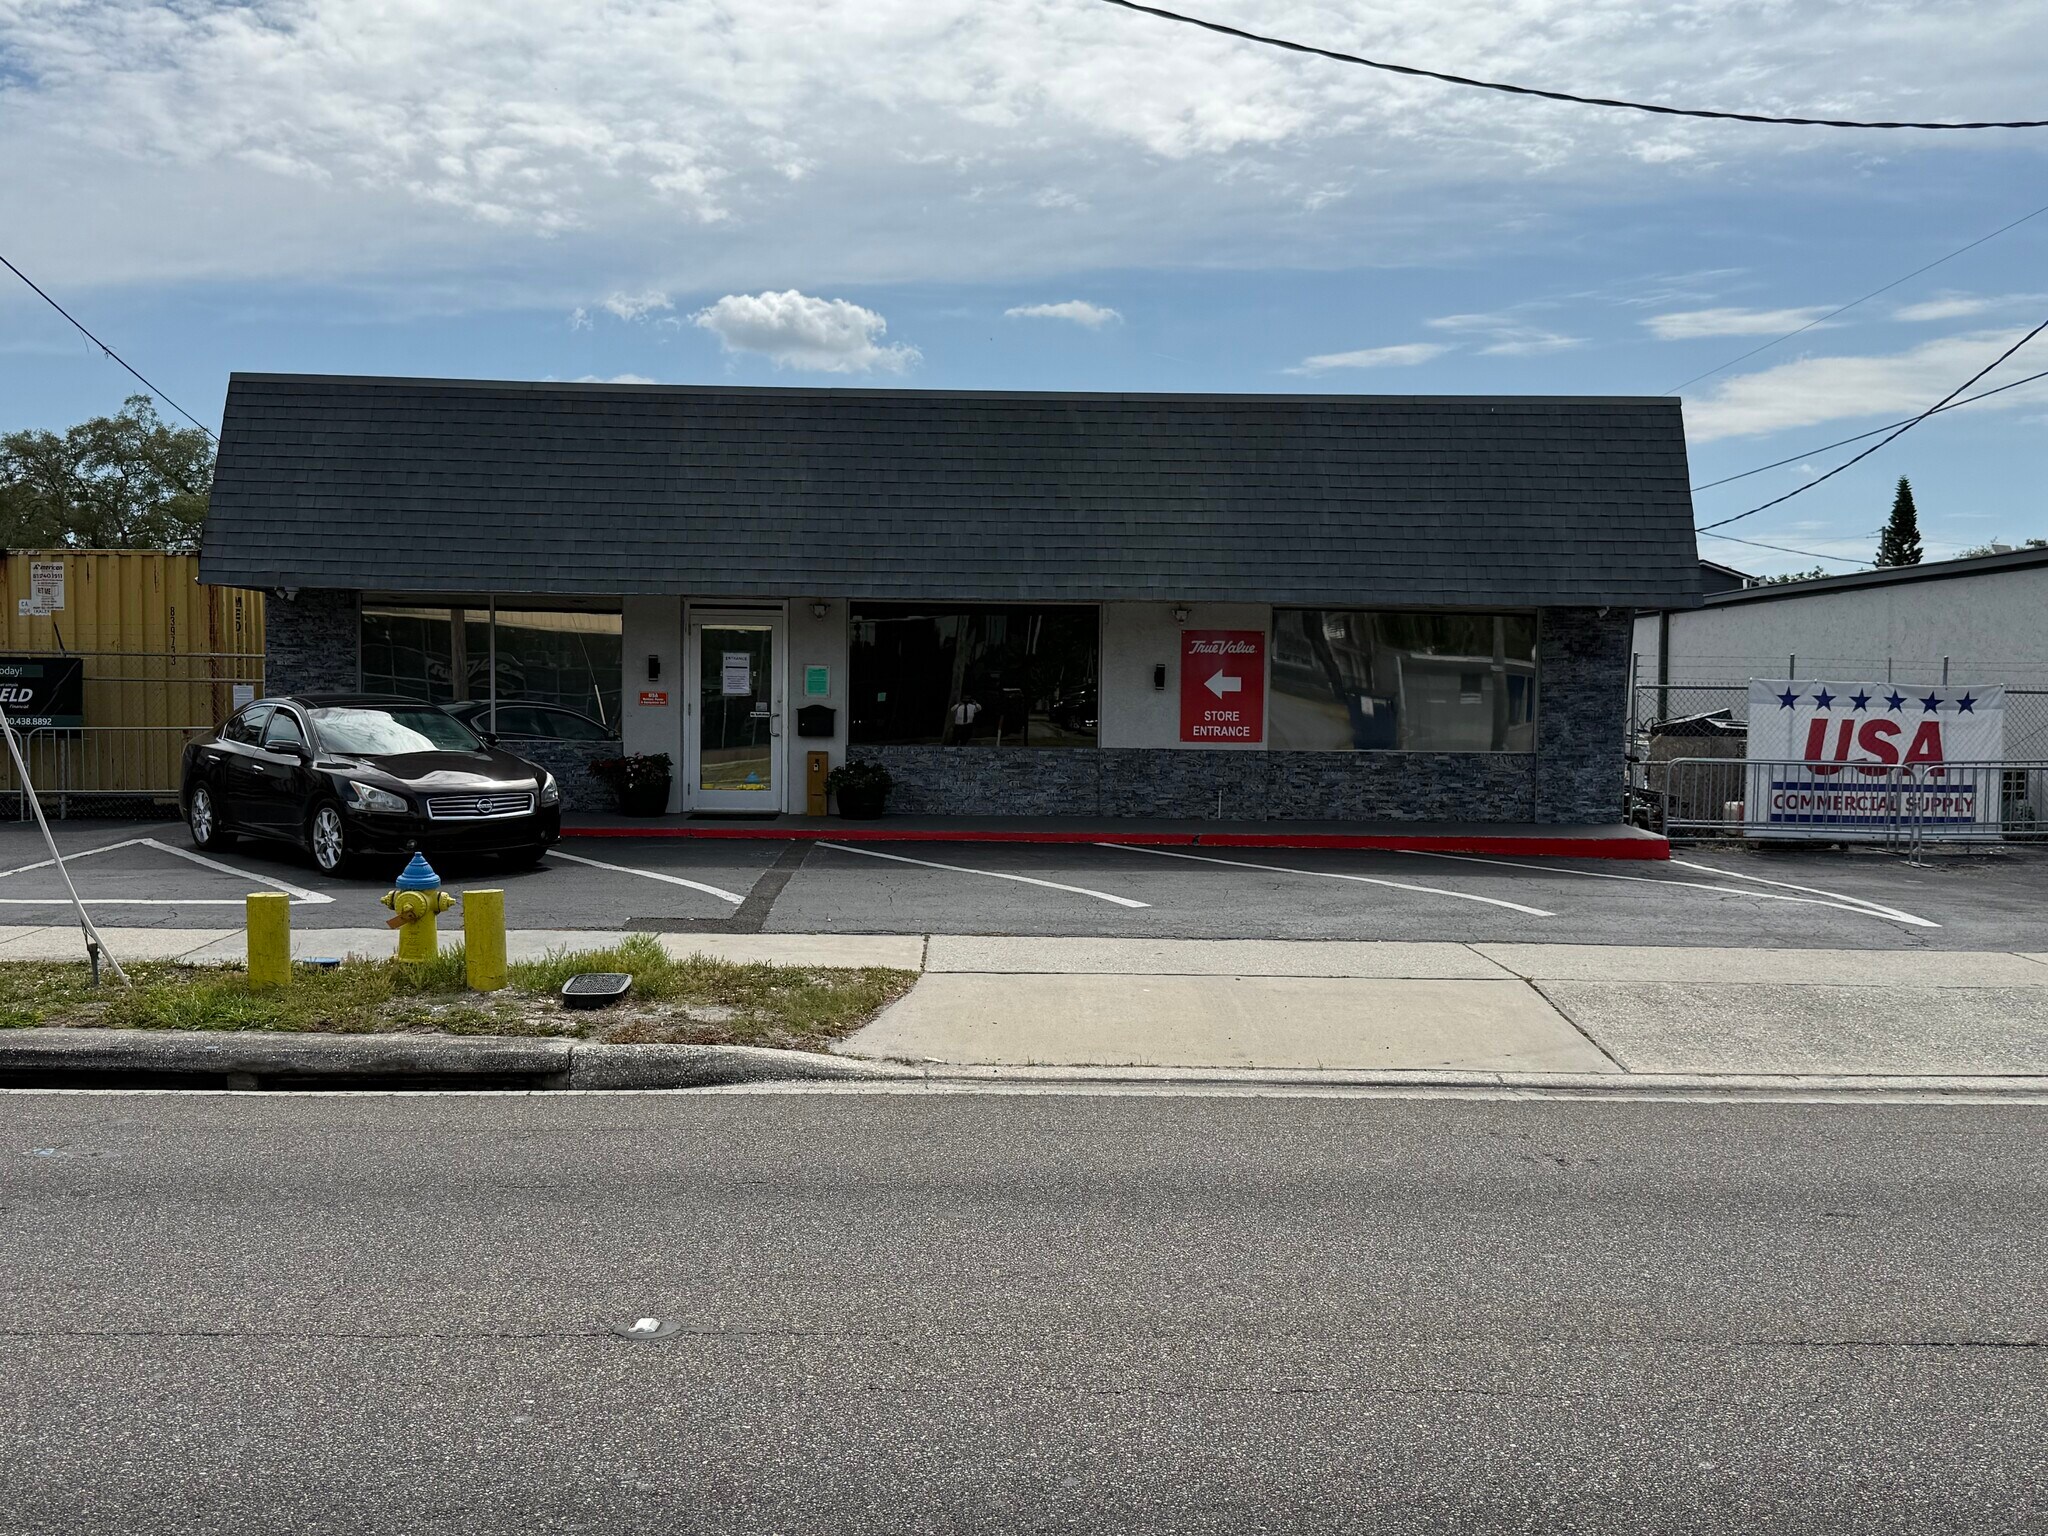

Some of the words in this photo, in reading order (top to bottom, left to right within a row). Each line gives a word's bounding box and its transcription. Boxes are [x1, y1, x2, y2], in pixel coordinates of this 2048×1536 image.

[0, 666, 23, 678] oday!
[0, 688, 34, 703] ELD
[1204, 711, 1240, 722] STORE
[1193, 726, 1250, 737] ENTRANCE
[1804, 718, 1945, 777] USA
[1773, 794, 1898, 812] COMMERCIAL
[1905, 795, 1974, 813] SUPPLY
